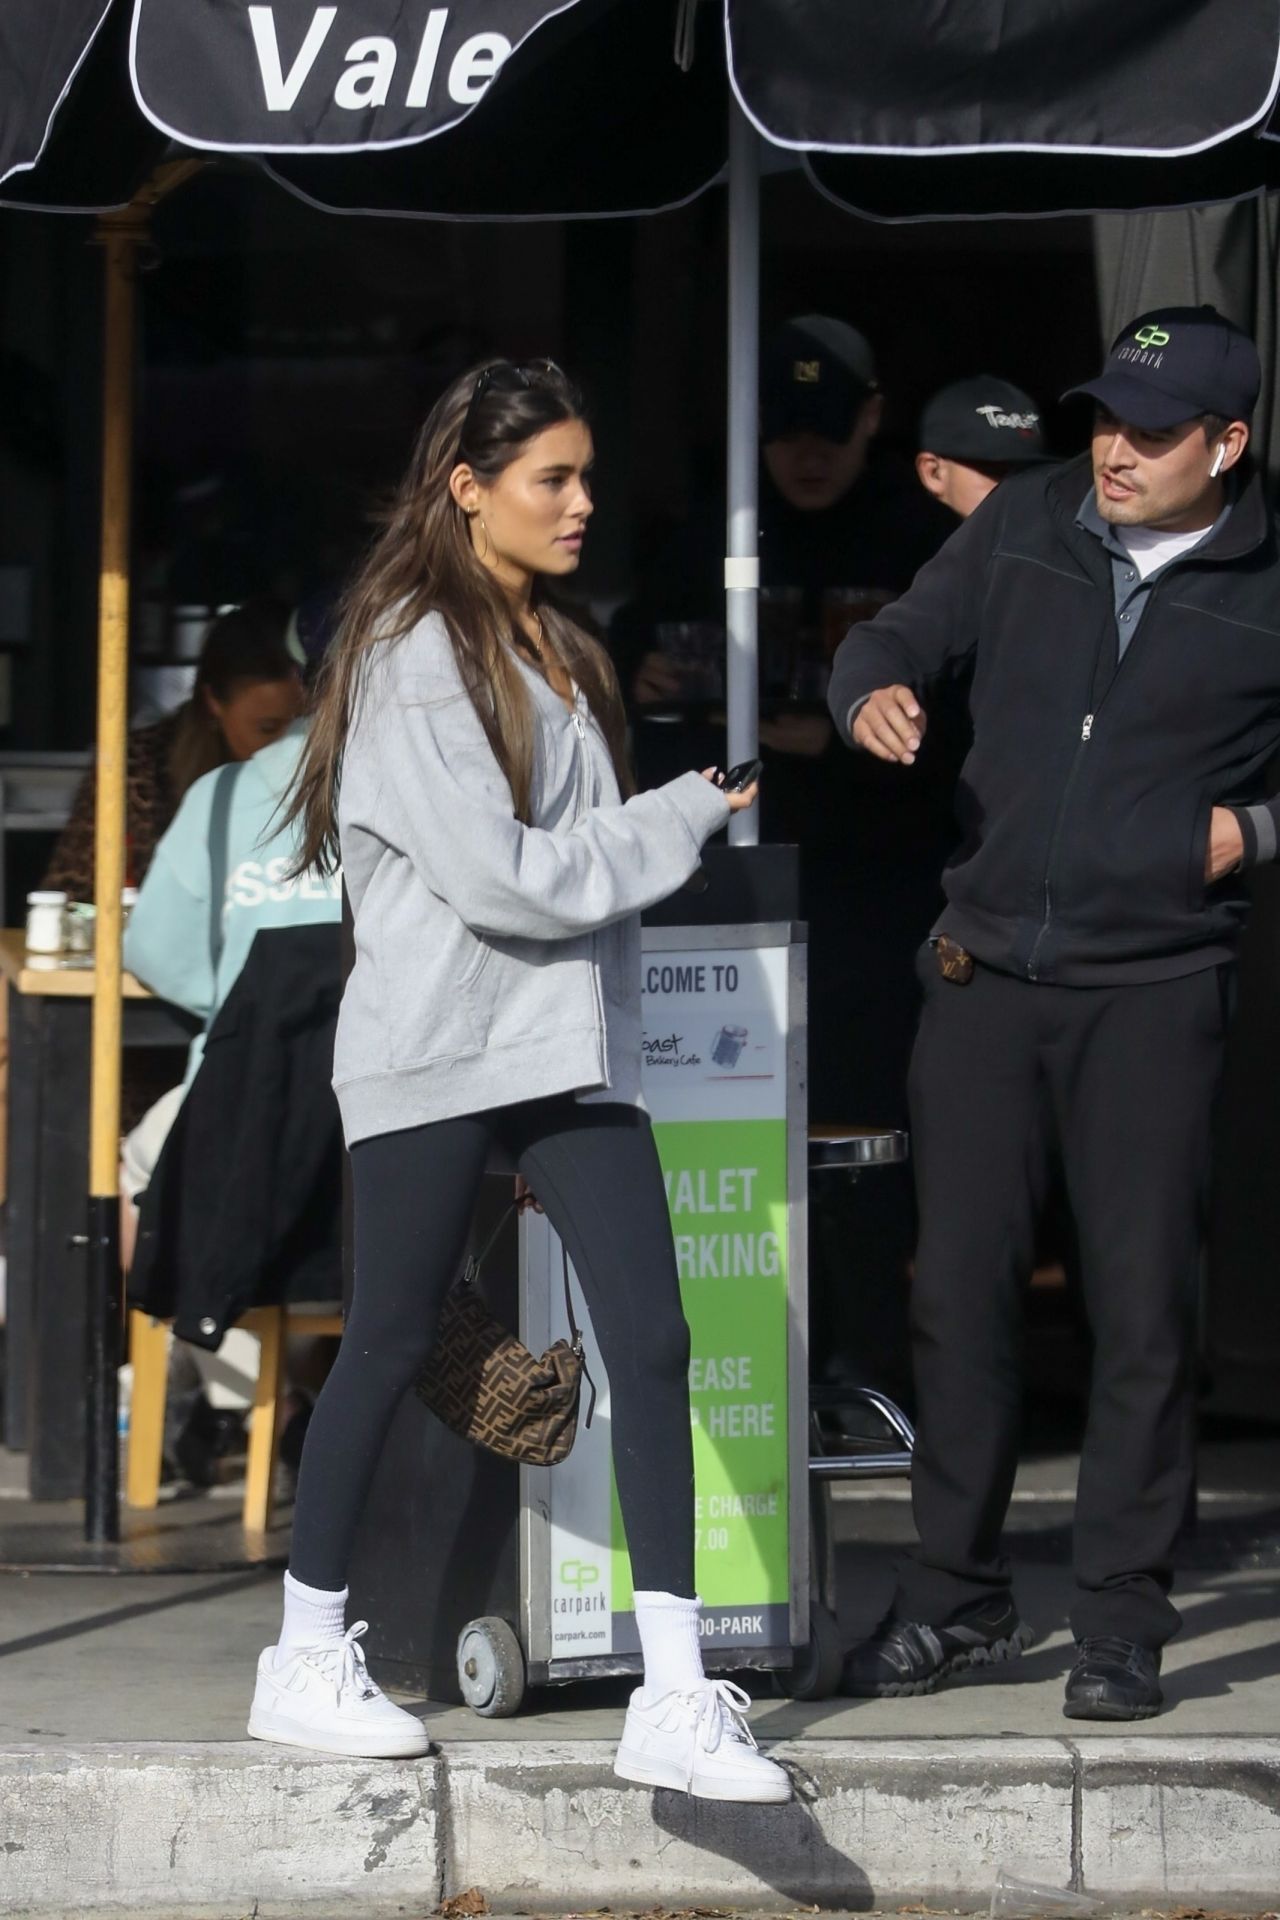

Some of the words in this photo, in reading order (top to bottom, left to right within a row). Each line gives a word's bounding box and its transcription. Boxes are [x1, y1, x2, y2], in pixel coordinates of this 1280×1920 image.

[641, 965, 706, 994] COME
[712, 965, 739, 993] TO
[641, 1031, 683, 1054] oast
[645, 1054, 679, 1067] Bakery
[709, 1403, 774, 1438] HERE
[709, 1494, 777, 1518] CHARGE
[554, 1592, 606, 1615] carpark
[554, 1630, 606, 1642] carpark.com
